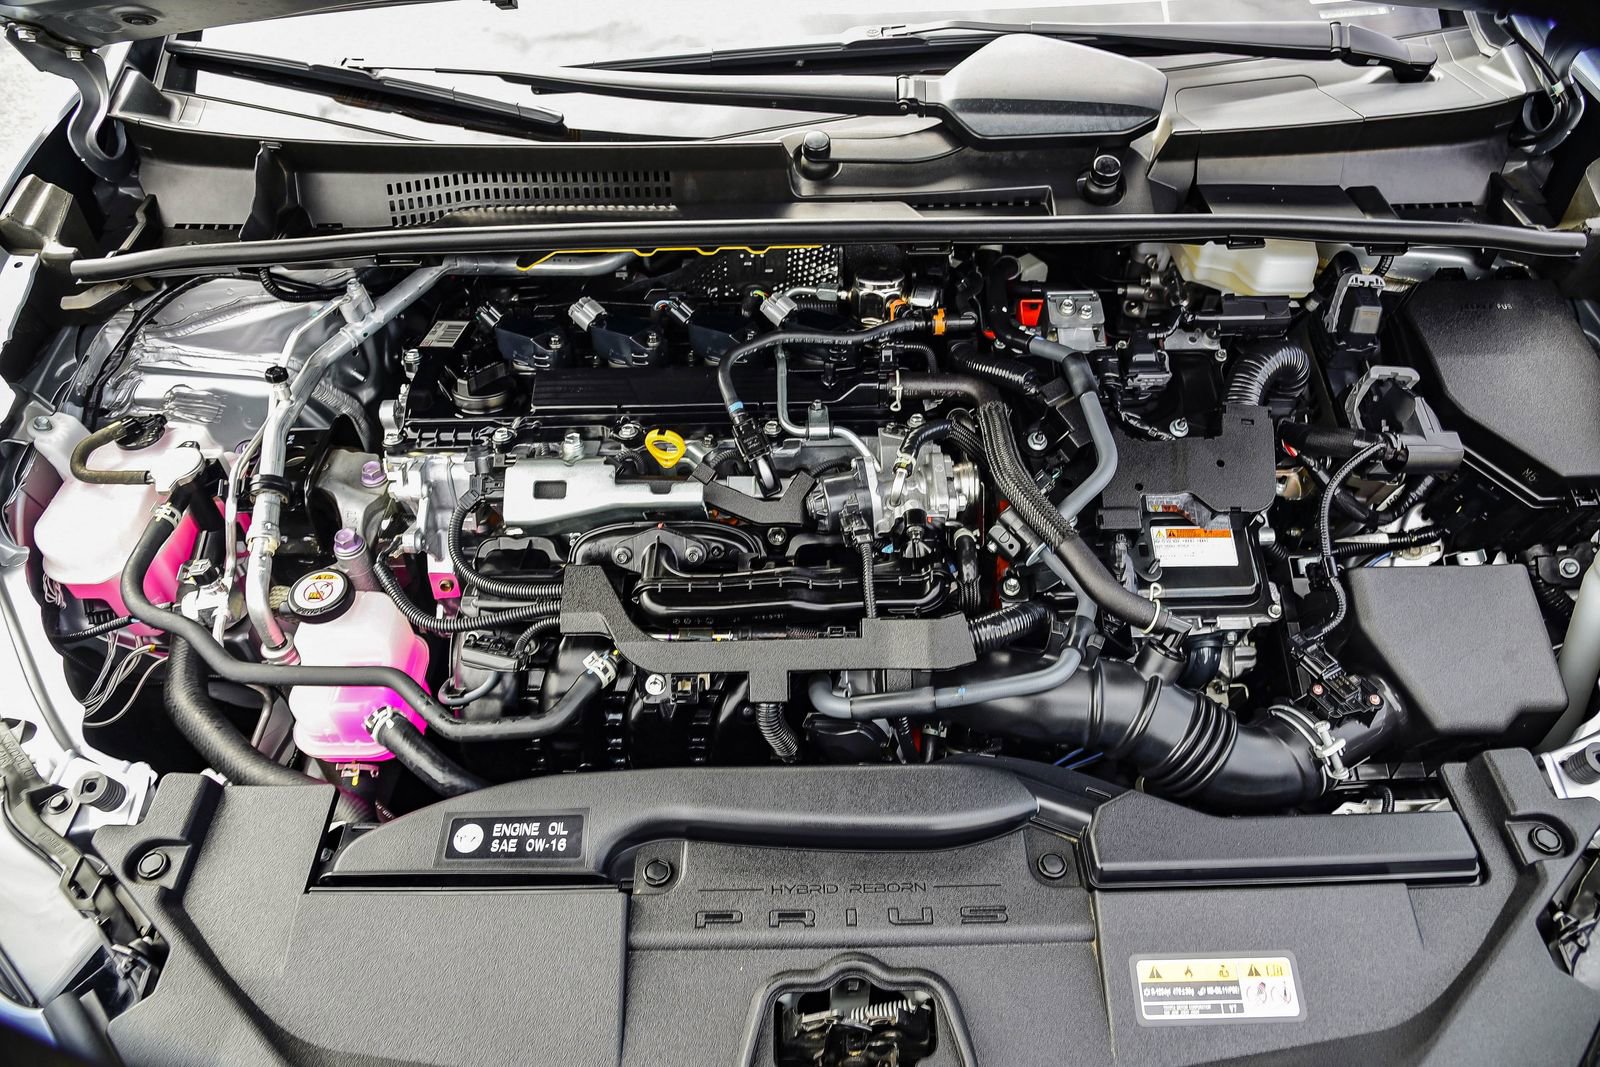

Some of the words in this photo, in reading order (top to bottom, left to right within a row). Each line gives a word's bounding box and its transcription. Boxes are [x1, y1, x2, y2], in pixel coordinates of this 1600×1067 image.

[492, 822, 540, 836] ENGINE
[548, 821, 568, 836] OIL
[490, 838, 518, 852] SAE
[525, 837, 567, 852] 0W-16
[770, 883, 839, 895] HYBRID
[850, 881, 927, 894] REBORN
[695, 905, 1008, 928] PRIUS
